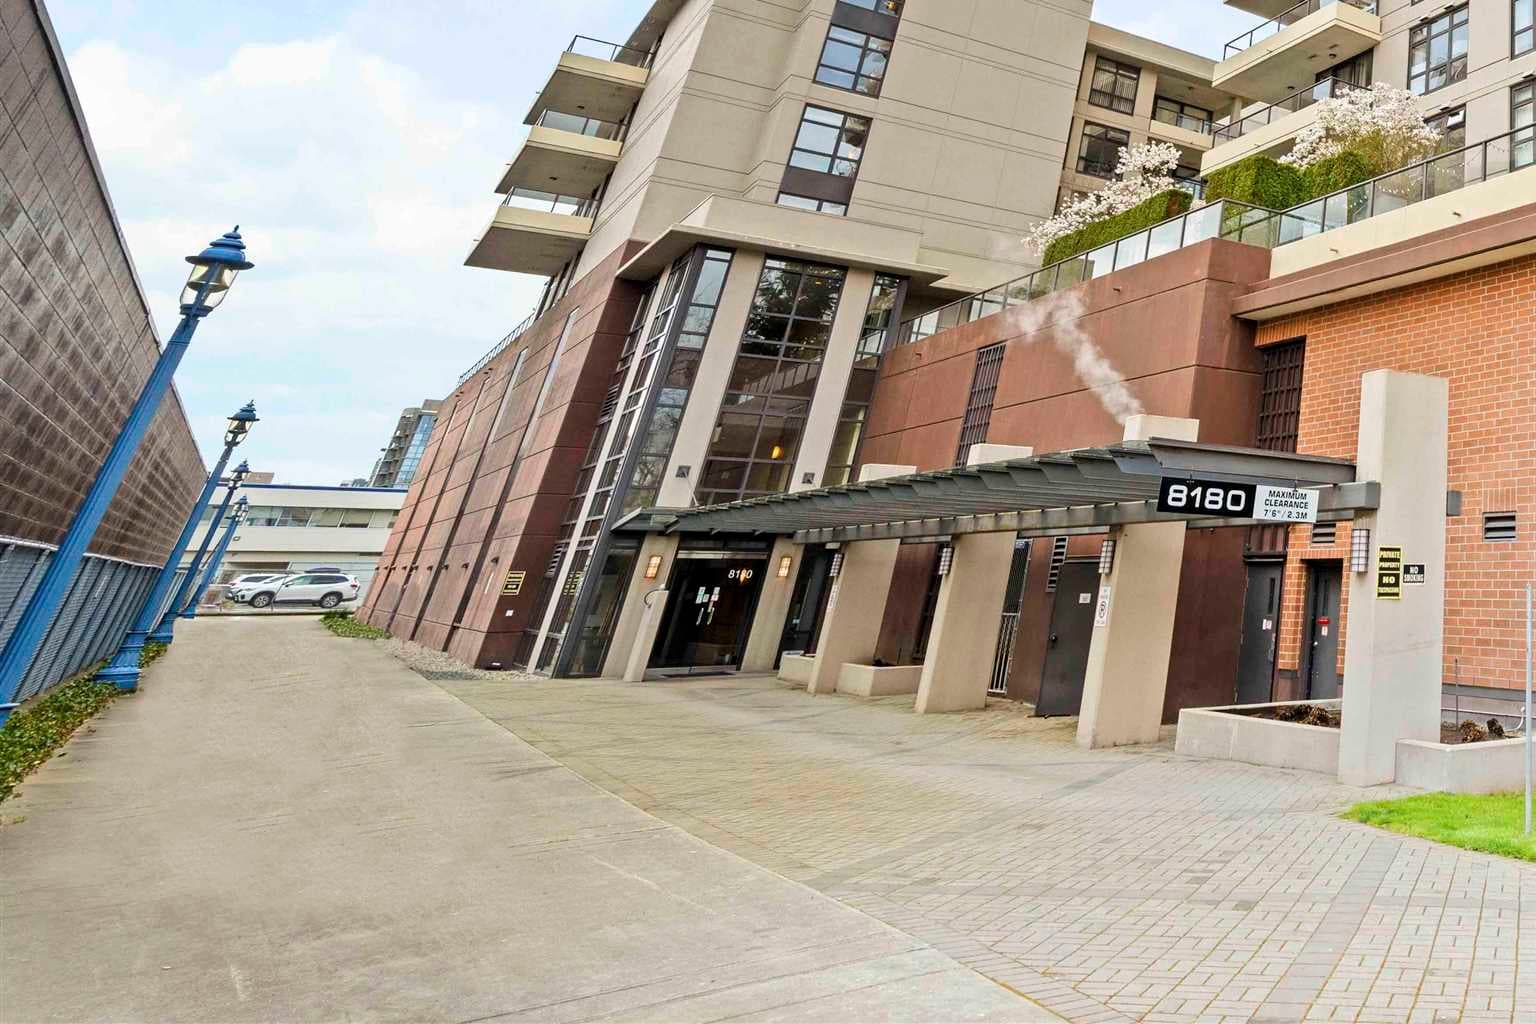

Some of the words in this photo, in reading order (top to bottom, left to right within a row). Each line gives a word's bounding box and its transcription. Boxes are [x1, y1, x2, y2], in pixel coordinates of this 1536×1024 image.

[1167, 484, 1246, 511] 8180
[1268, 490, 1307, 500] MAXIMUM
[1264, 499, 1309, 510] CLEARANCE
[727, 569, 753, 579] 8180
[1409, 566, 1419, 574] NO
[1382, 576, 1396, 584] NO
